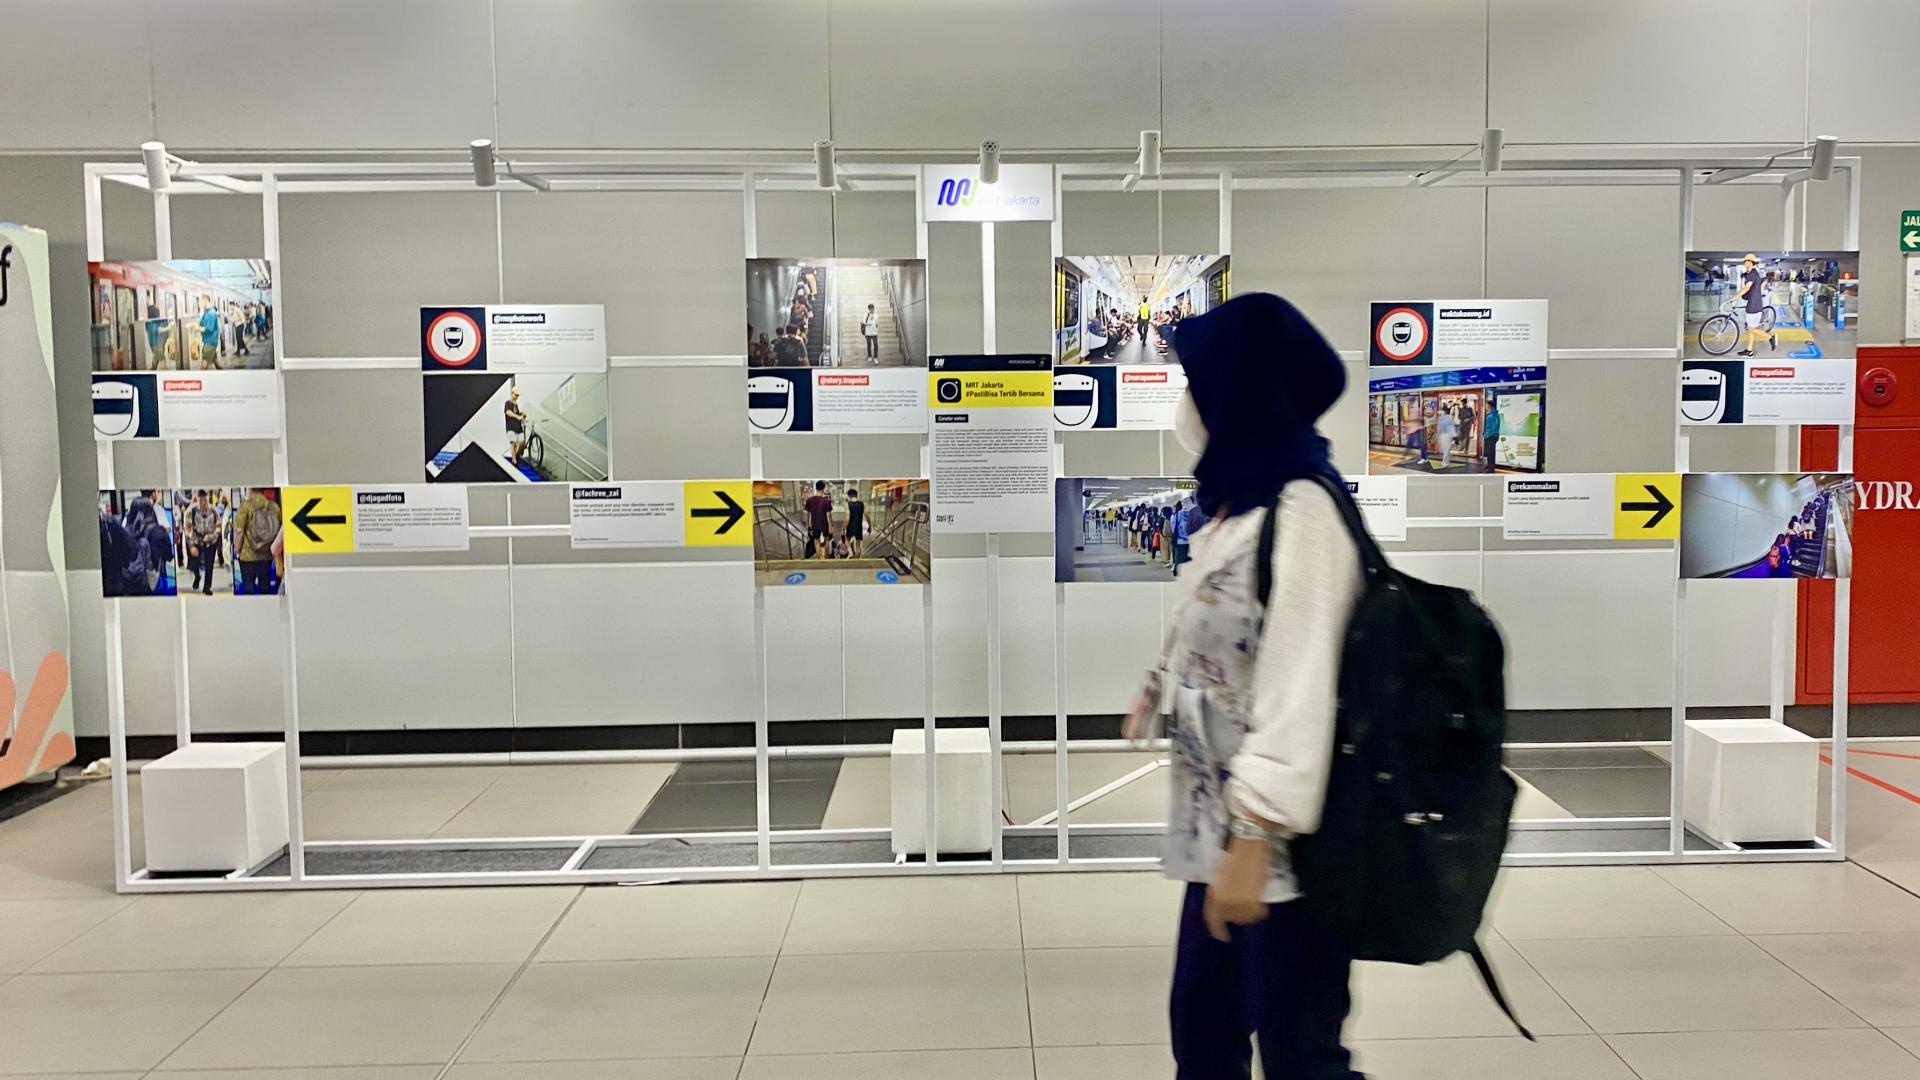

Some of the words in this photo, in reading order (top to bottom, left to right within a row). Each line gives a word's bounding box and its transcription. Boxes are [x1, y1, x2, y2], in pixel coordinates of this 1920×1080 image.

[1510, 483, 1558, 491] @rekammalam
[575, 489, 620, 498] @fachree_zal
[1854, 481, 1920, 510] YDR
[360, 494, 402, 503] @djagadfoto
